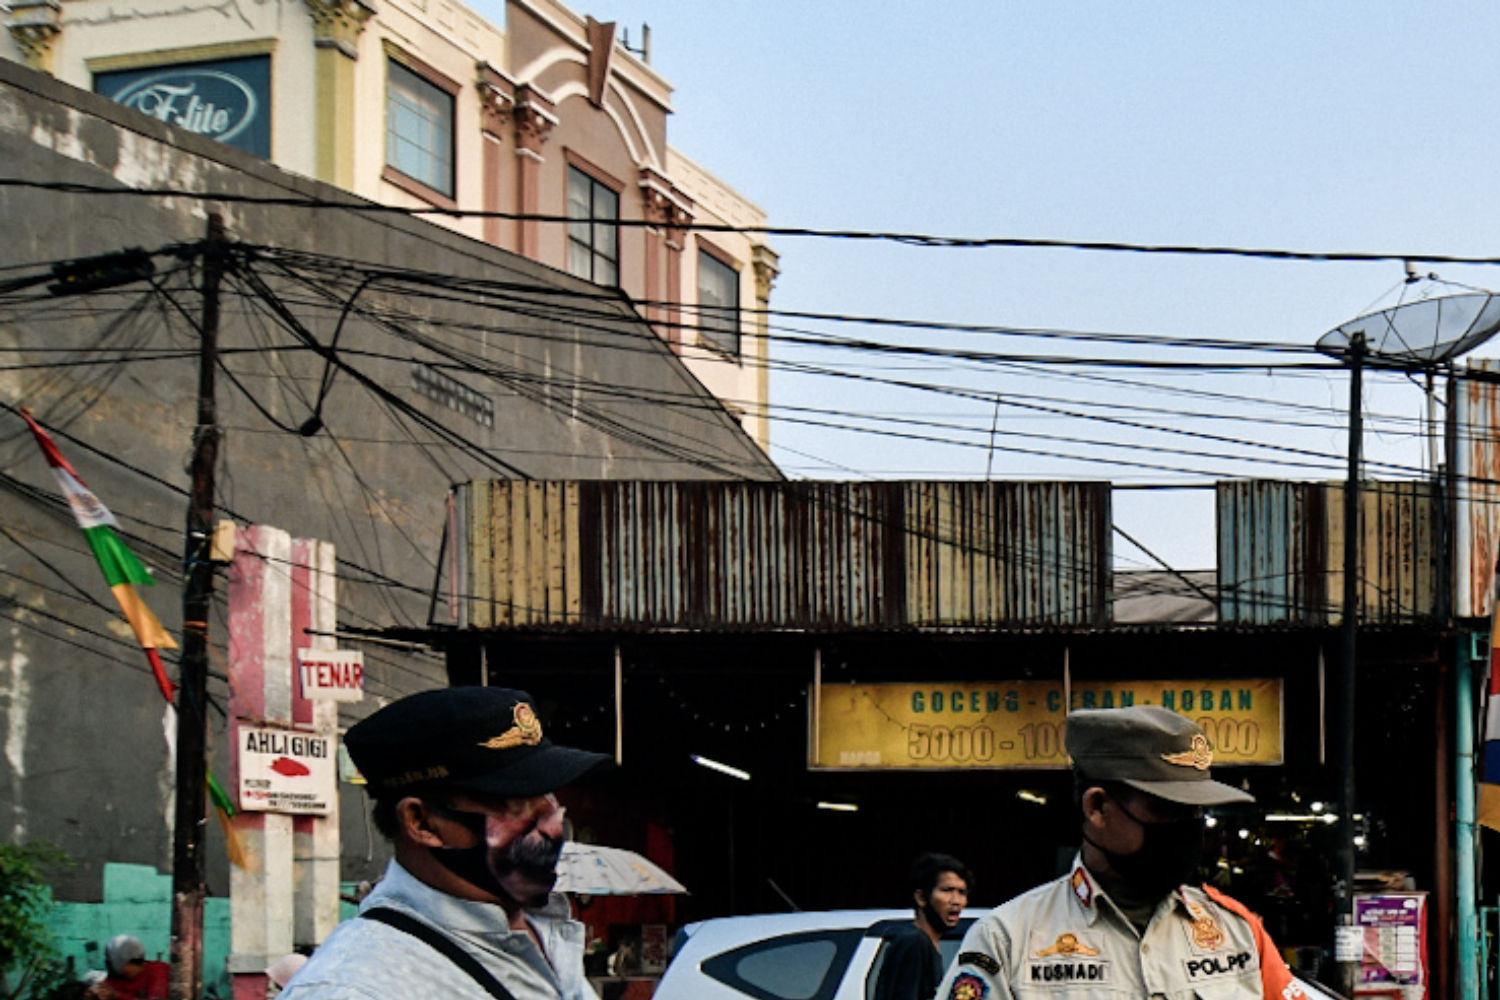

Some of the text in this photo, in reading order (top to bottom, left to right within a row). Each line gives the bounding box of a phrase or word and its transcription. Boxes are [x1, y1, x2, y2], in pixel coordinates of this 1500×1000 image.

[301, 662, 364, 688] TENAR
[911, 690, 1020, 714] GOCENG
[1162, 688, 1253, 712] NOBAN
[246, 731, 328, 759] AHLI GIGI
[908, 723, 995, 762] 5000
[1030, 963, 1105, 981] KUSNADI
